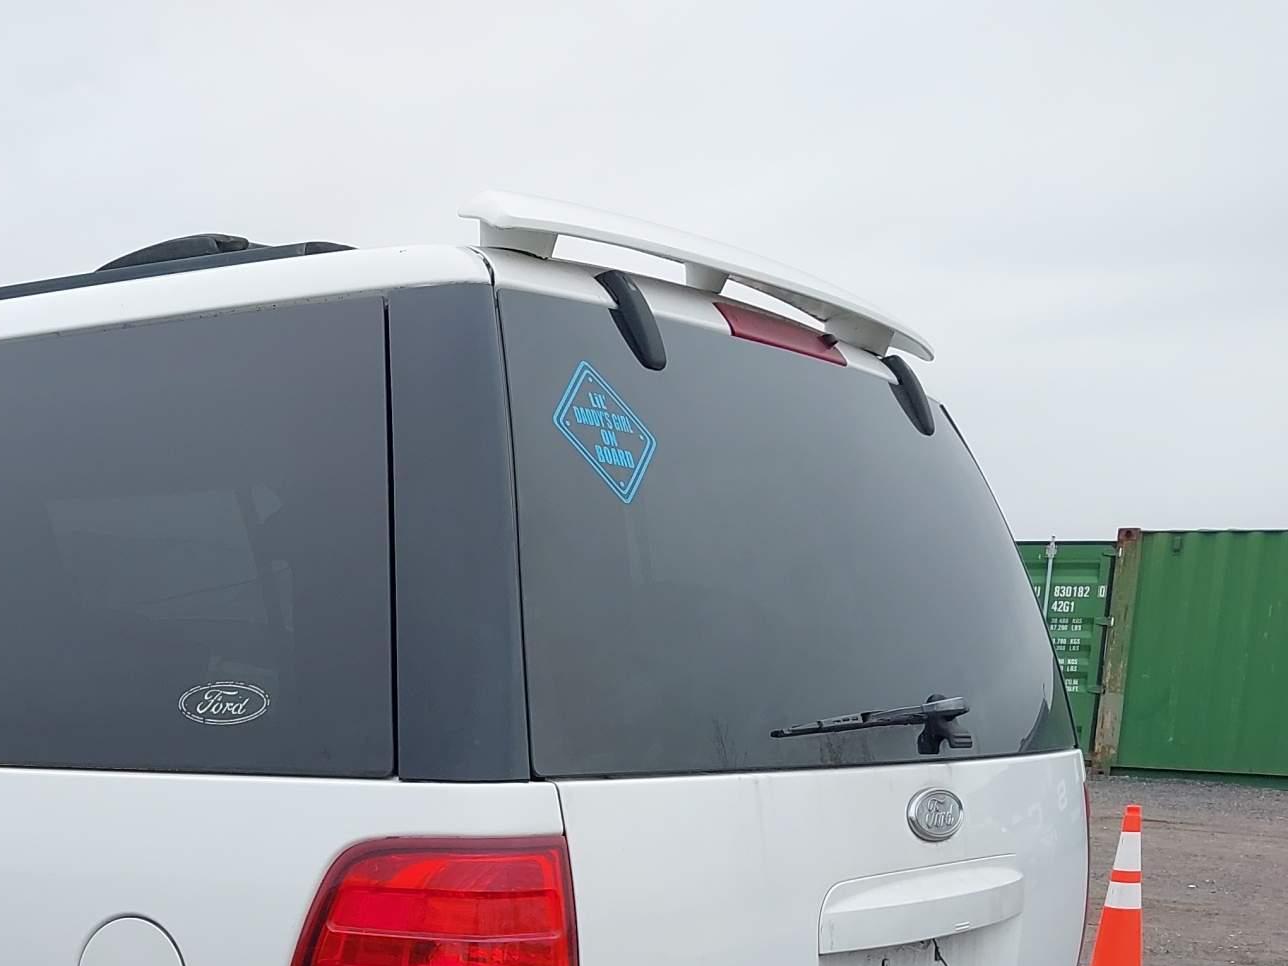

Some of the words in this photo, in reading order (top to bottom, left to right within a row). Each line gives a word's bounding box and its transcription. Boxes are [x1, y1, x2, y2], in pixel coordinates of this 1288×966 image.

[573, 406, 613, 430] DADDY'S
[612, 413, 634, 434] GIRL
[600, 429, 618, 447] ON
[595, 445, 635, 469] BOARD
[1053, 585, 1091, 598] 830182
[1050, 600, 1075, 613] 42G1
[196, 689, 249, 715] Ford
[925, 797, 954, 829] Ford
